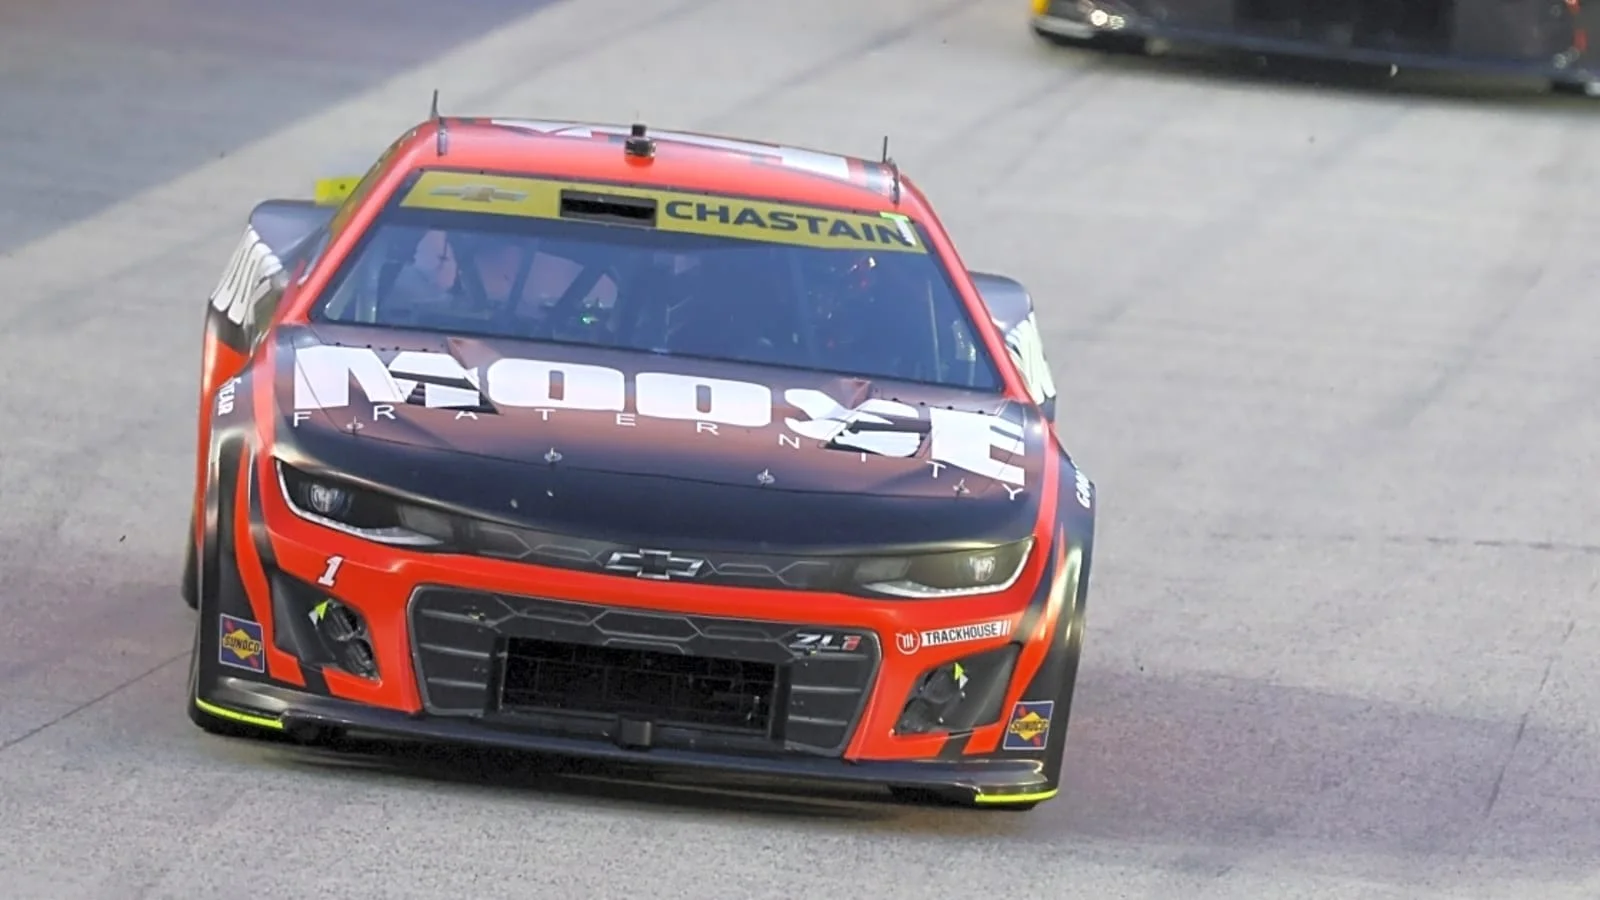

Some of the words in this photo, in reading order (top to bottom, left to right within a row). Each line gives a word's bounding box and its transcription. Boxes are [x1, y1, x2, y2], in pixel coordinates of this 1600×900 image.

[664, 200, 915, 247] CHASTAIN
[295, 344, 1025, 486] MOOSE
[293, 404, 1023, 500] FRATERNITY
[317, 555, 344, 588] 1
[223, 634, 261, 654] SUNOCO
[926, 622, 998, 645] TRACKHOUSE
